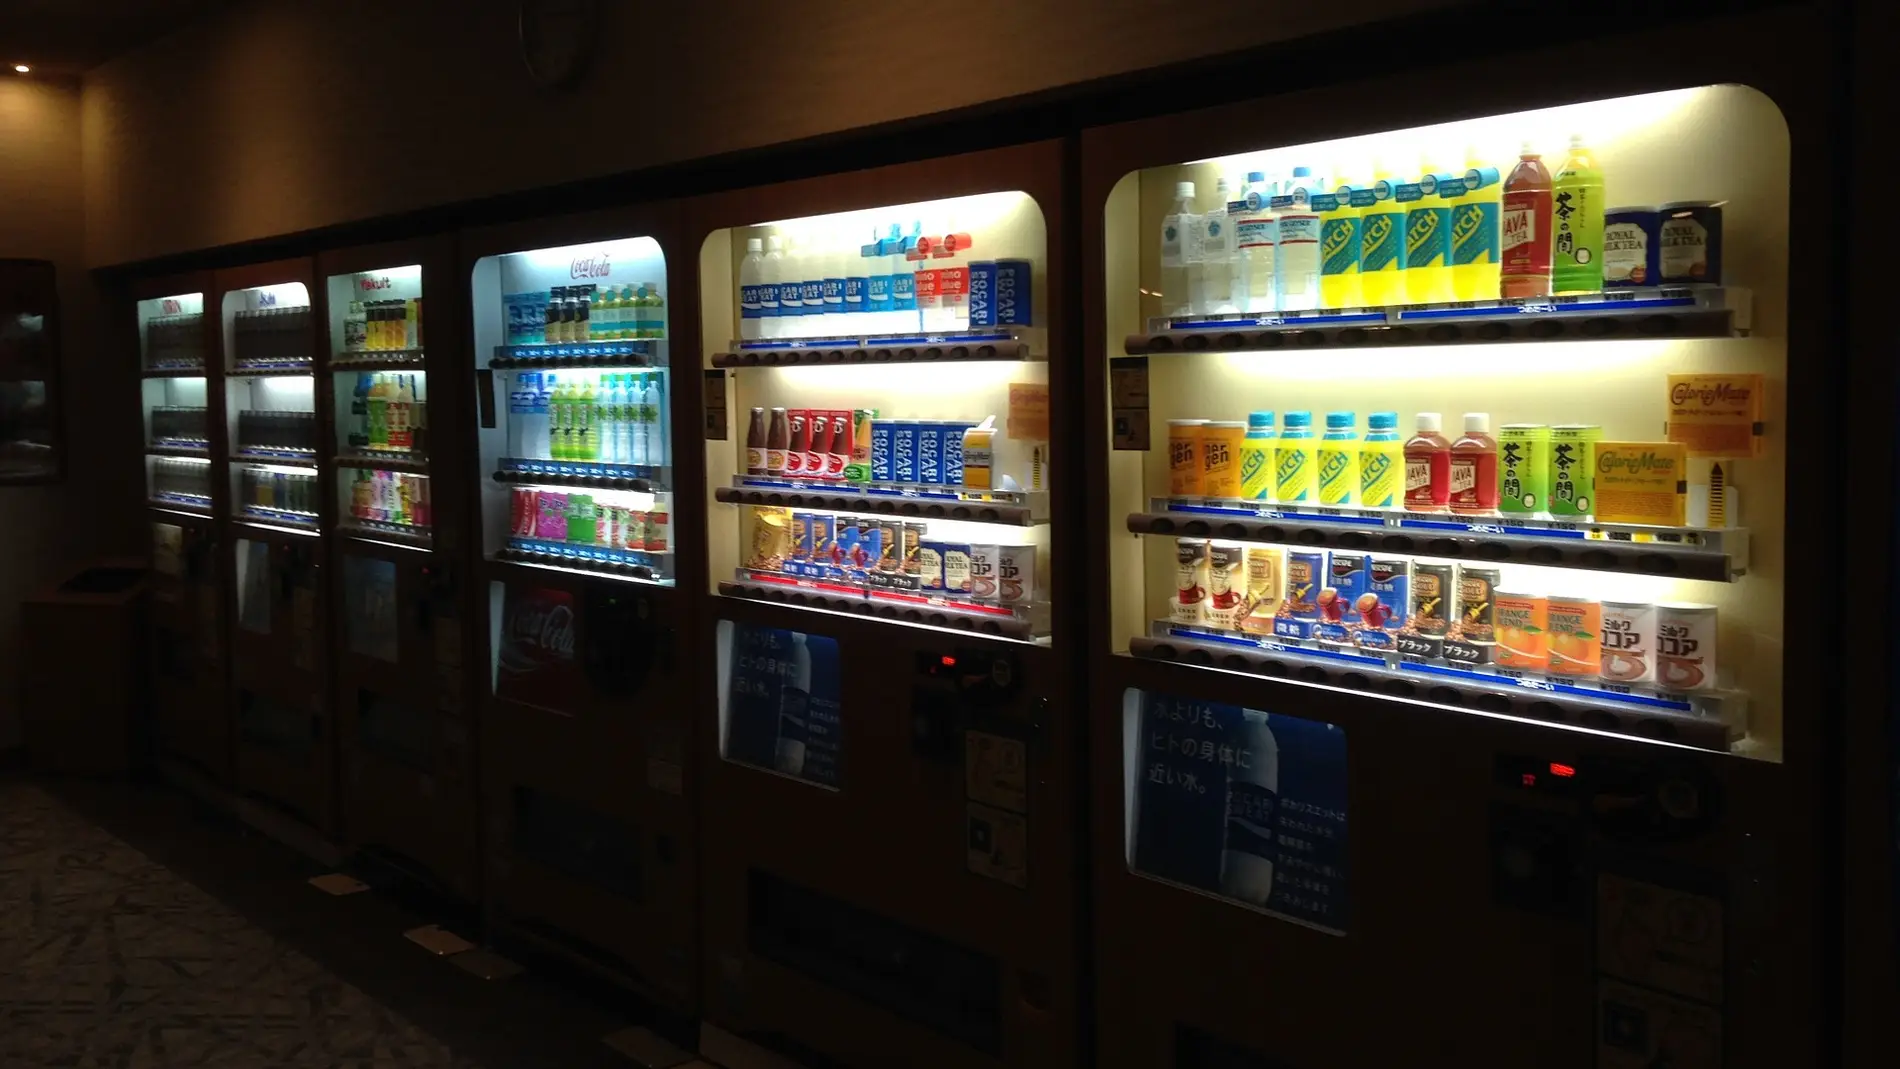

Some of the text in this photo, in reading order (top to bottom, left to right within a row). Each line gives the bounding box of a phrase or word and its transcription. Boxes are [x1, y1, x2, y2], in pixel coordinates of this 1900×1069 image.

[1556, 191, 1576, 254] 茶の間
[360, 276, 392, 290] Yakult
[977, 271, 988, 325] POCARI
[1503, 442, 1524, 500] 茶の間
[1554, 443, 1577, 503] 茶の間
[1398, 639, 1432, 652] ブラック
[1444, 645, 1480, 659] ブラック
[1153, 700, 1224, 731] 水よりも、
[1151, 731, 1252, 769] ヒトの身体に
[1149, 763, 1206, 795] 近い水。
